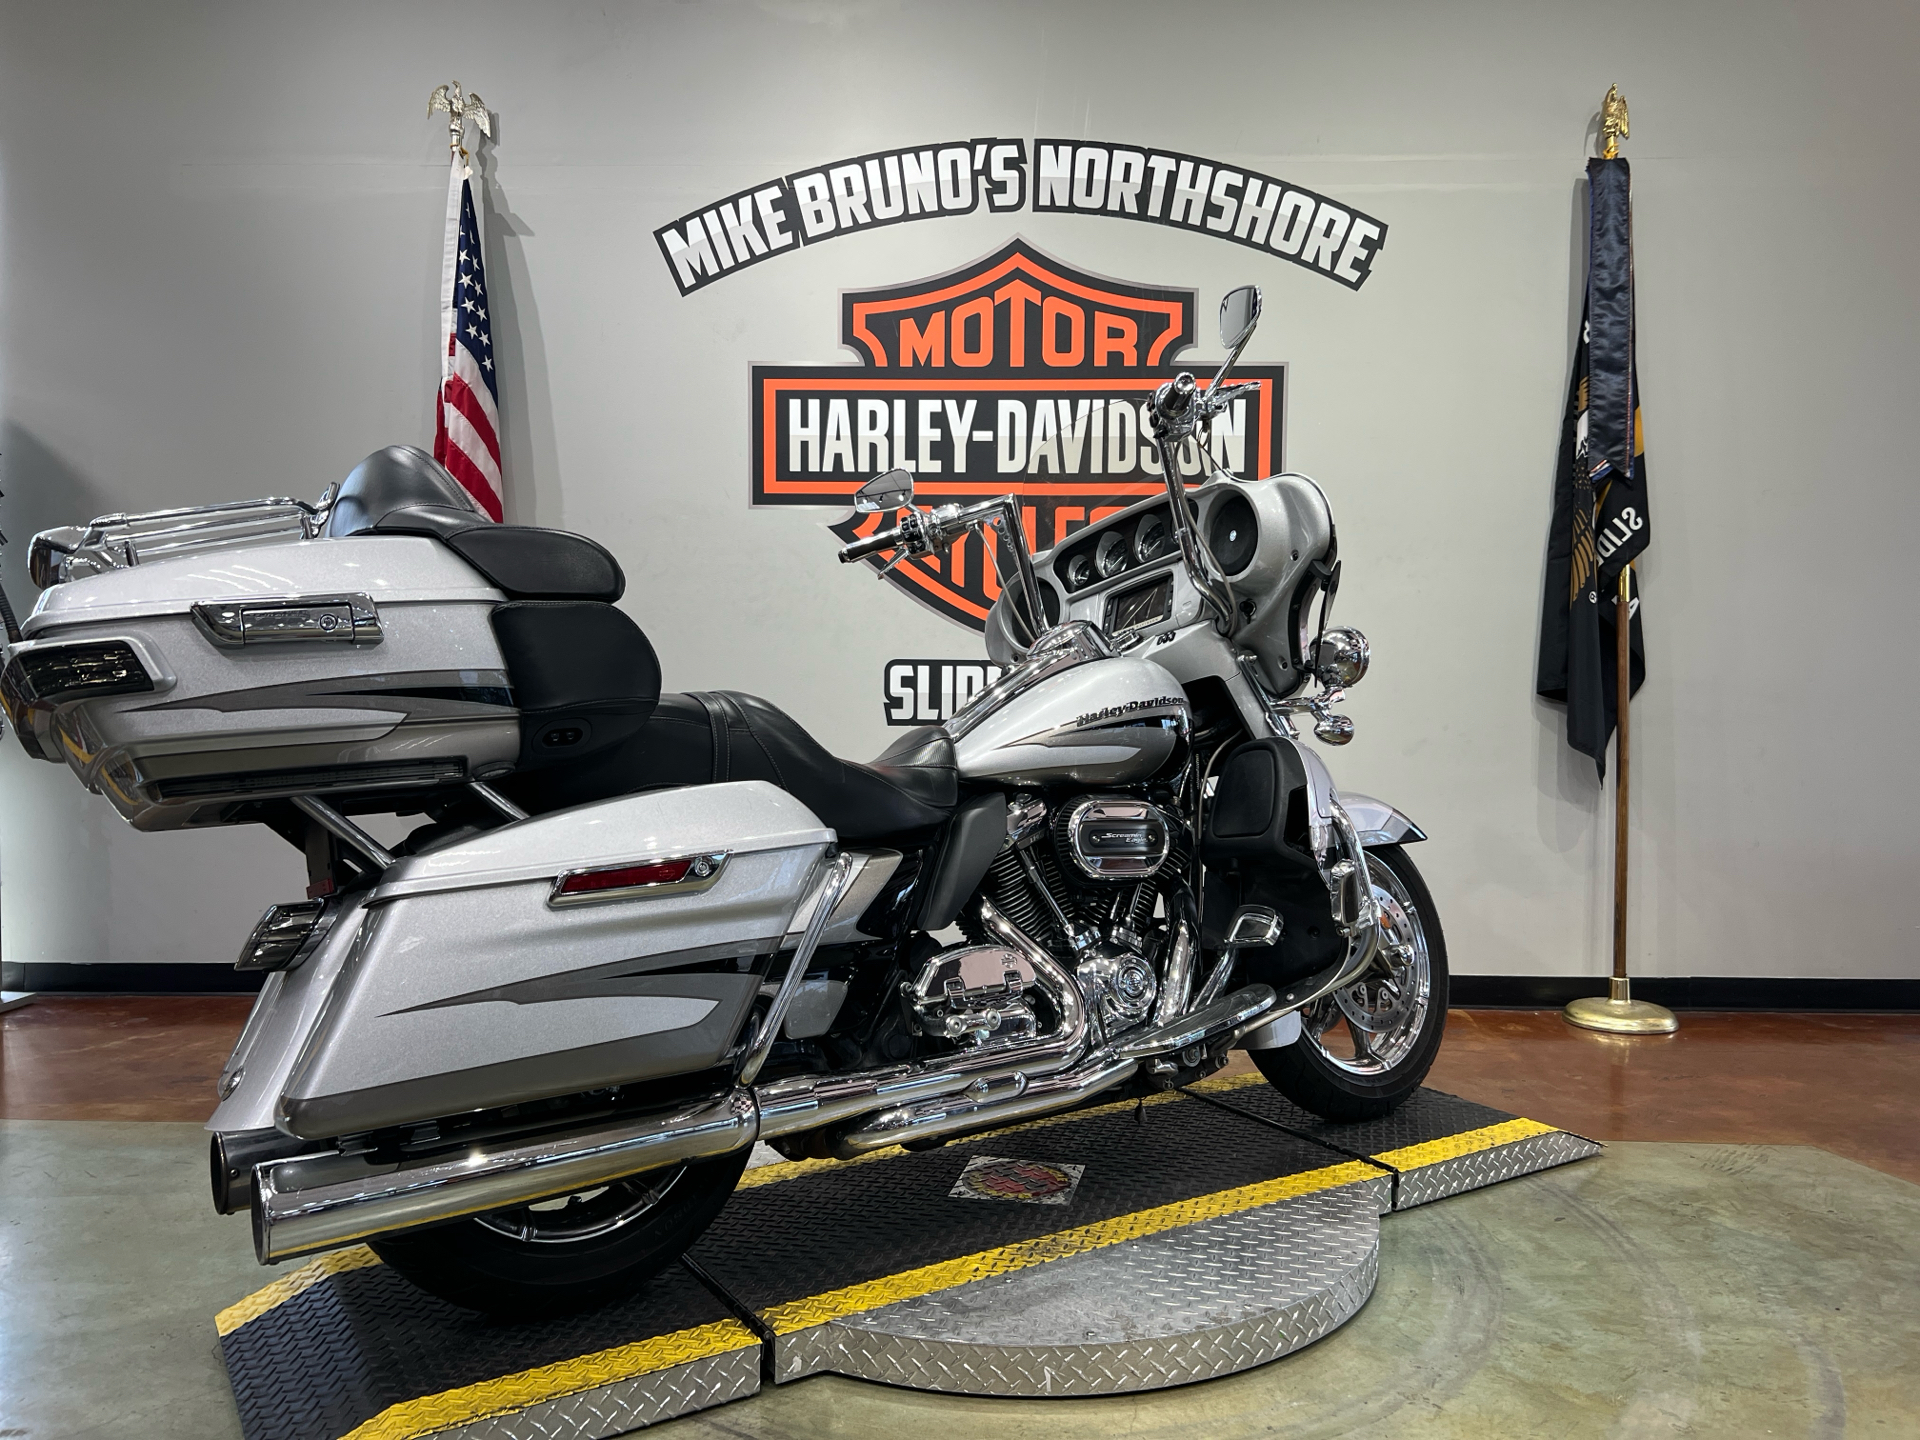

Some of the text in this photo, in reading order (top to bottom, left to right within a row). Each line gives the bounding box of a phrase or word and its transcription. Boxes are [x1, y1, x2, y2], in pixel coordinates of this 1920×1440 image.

[661, 144, 1381, 288] MIKE BRUNO'S NORTHSHORE
[899, 279, 1138, 368] MOTOR
[889, 665, 1002, 720] SLID
